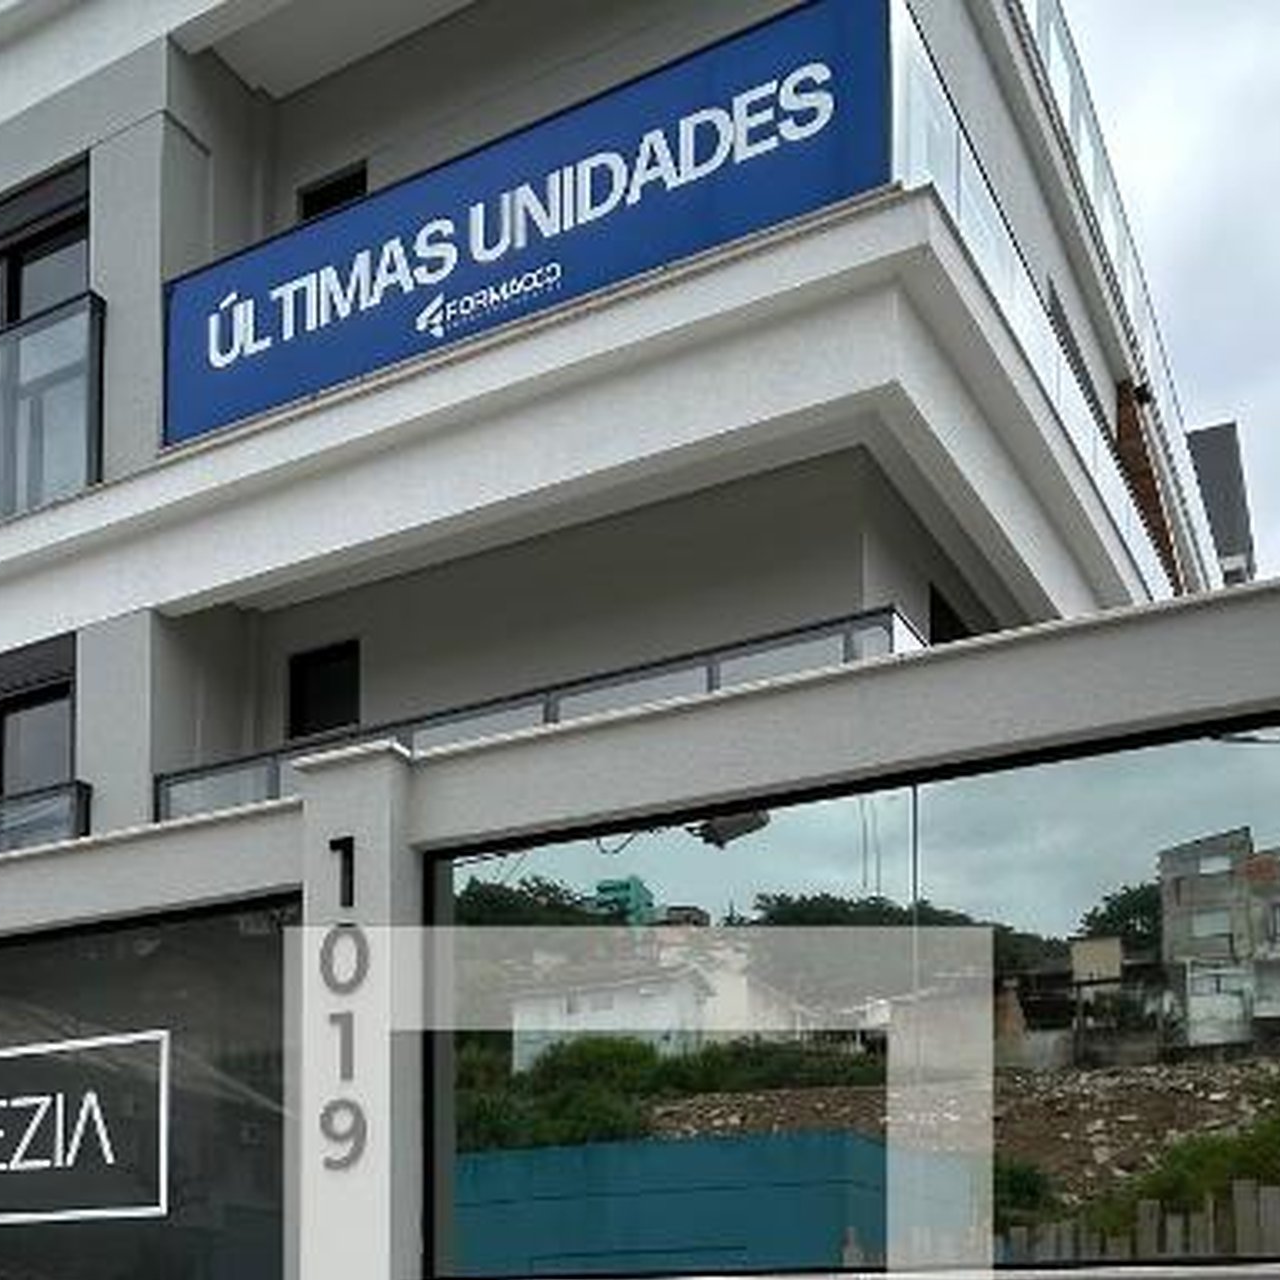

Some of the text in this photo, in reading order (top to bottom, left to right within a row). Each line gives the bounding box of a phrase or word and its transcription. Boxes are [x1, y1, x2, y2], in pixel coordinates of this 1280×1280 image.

[207, 62, 836, 369] ÚLTIMAS UNIDADES
[320, 836, 370, 1171] 1019
